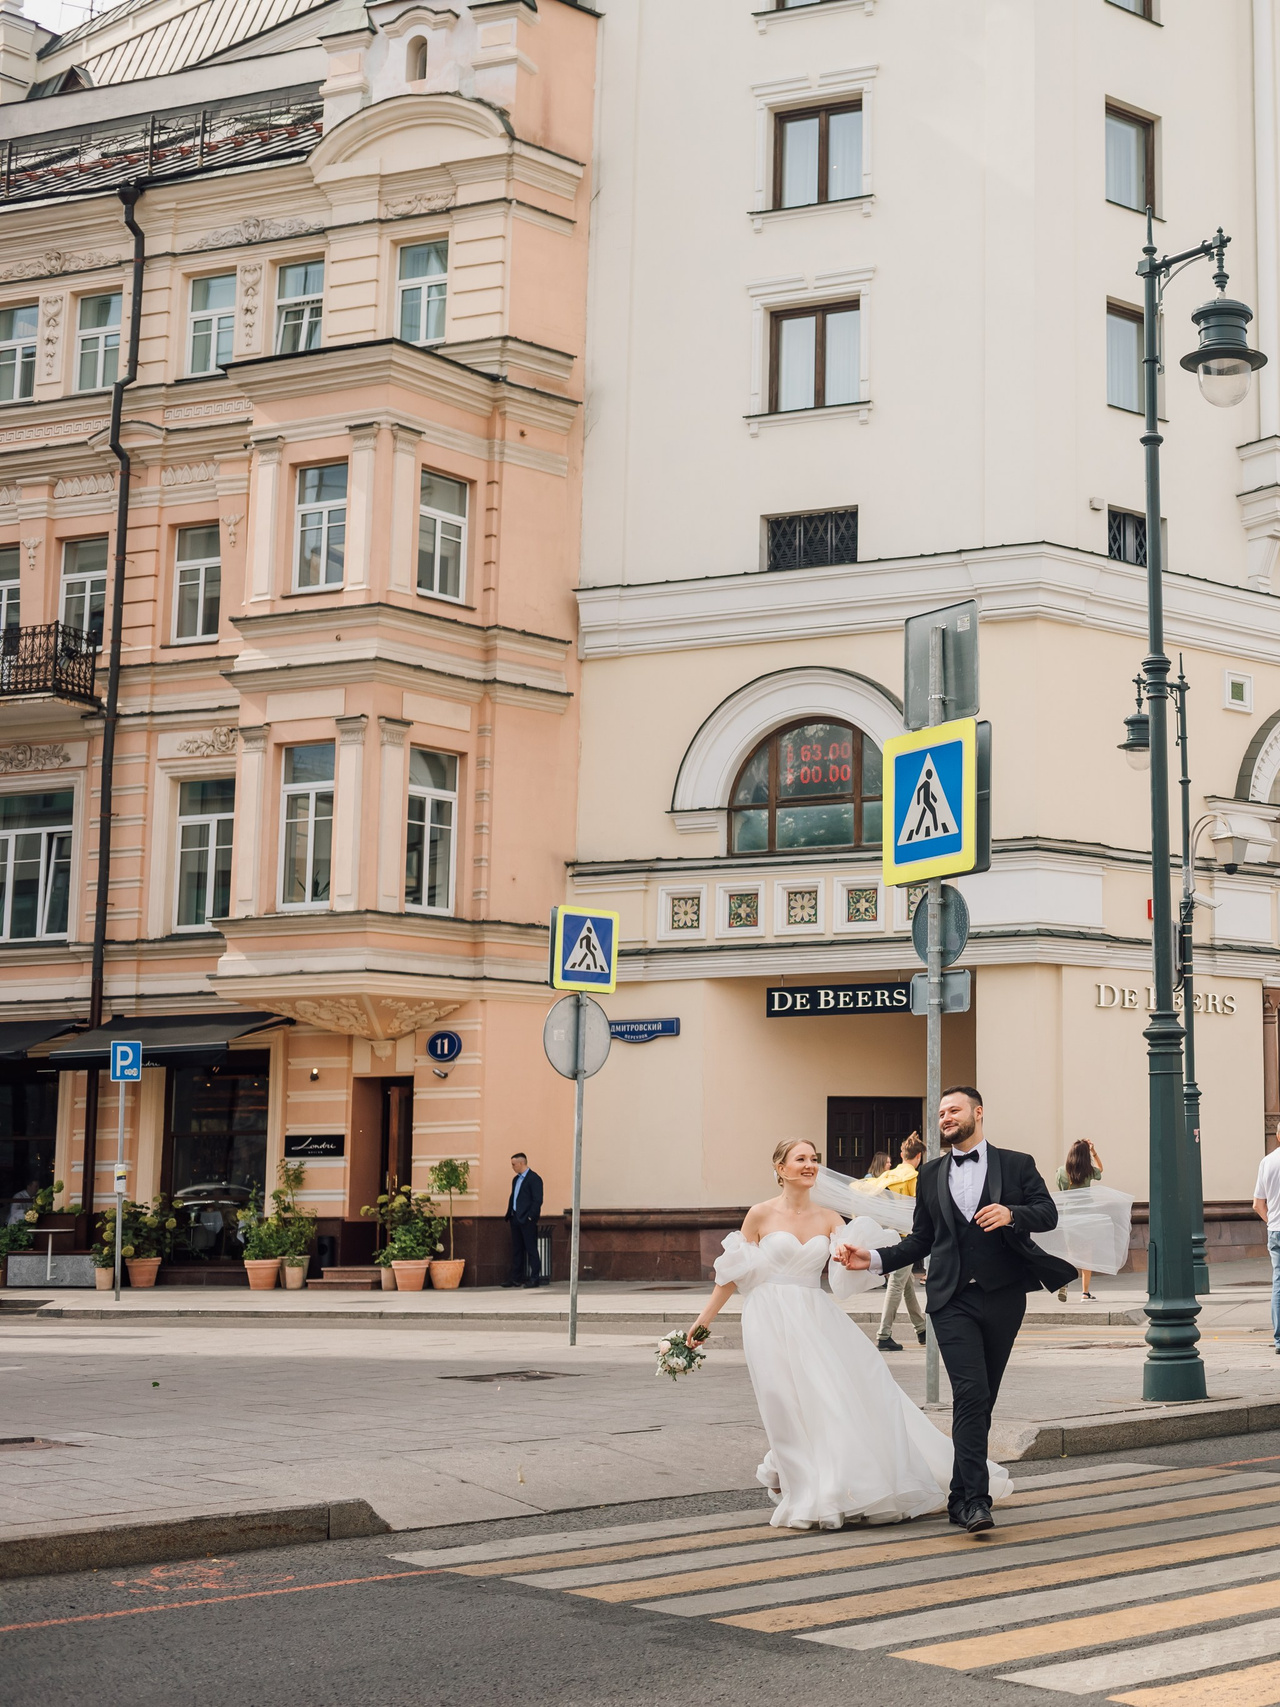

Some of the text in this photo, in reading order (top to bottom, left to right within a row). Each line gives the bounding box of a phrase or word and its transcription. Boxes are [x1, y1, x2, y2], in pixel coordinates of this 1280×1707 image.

[801, 742, 850, 761] 63.00
[800, 764, 850, 784] 00.00
[771, 988, 908, 1011] DE BEERS
[1096, 983, 1139, 1009] DE
[610, 1022, 663, 1033] ДМИТРОВСКИЙ
[435, 1037, 449, 1055] 11
